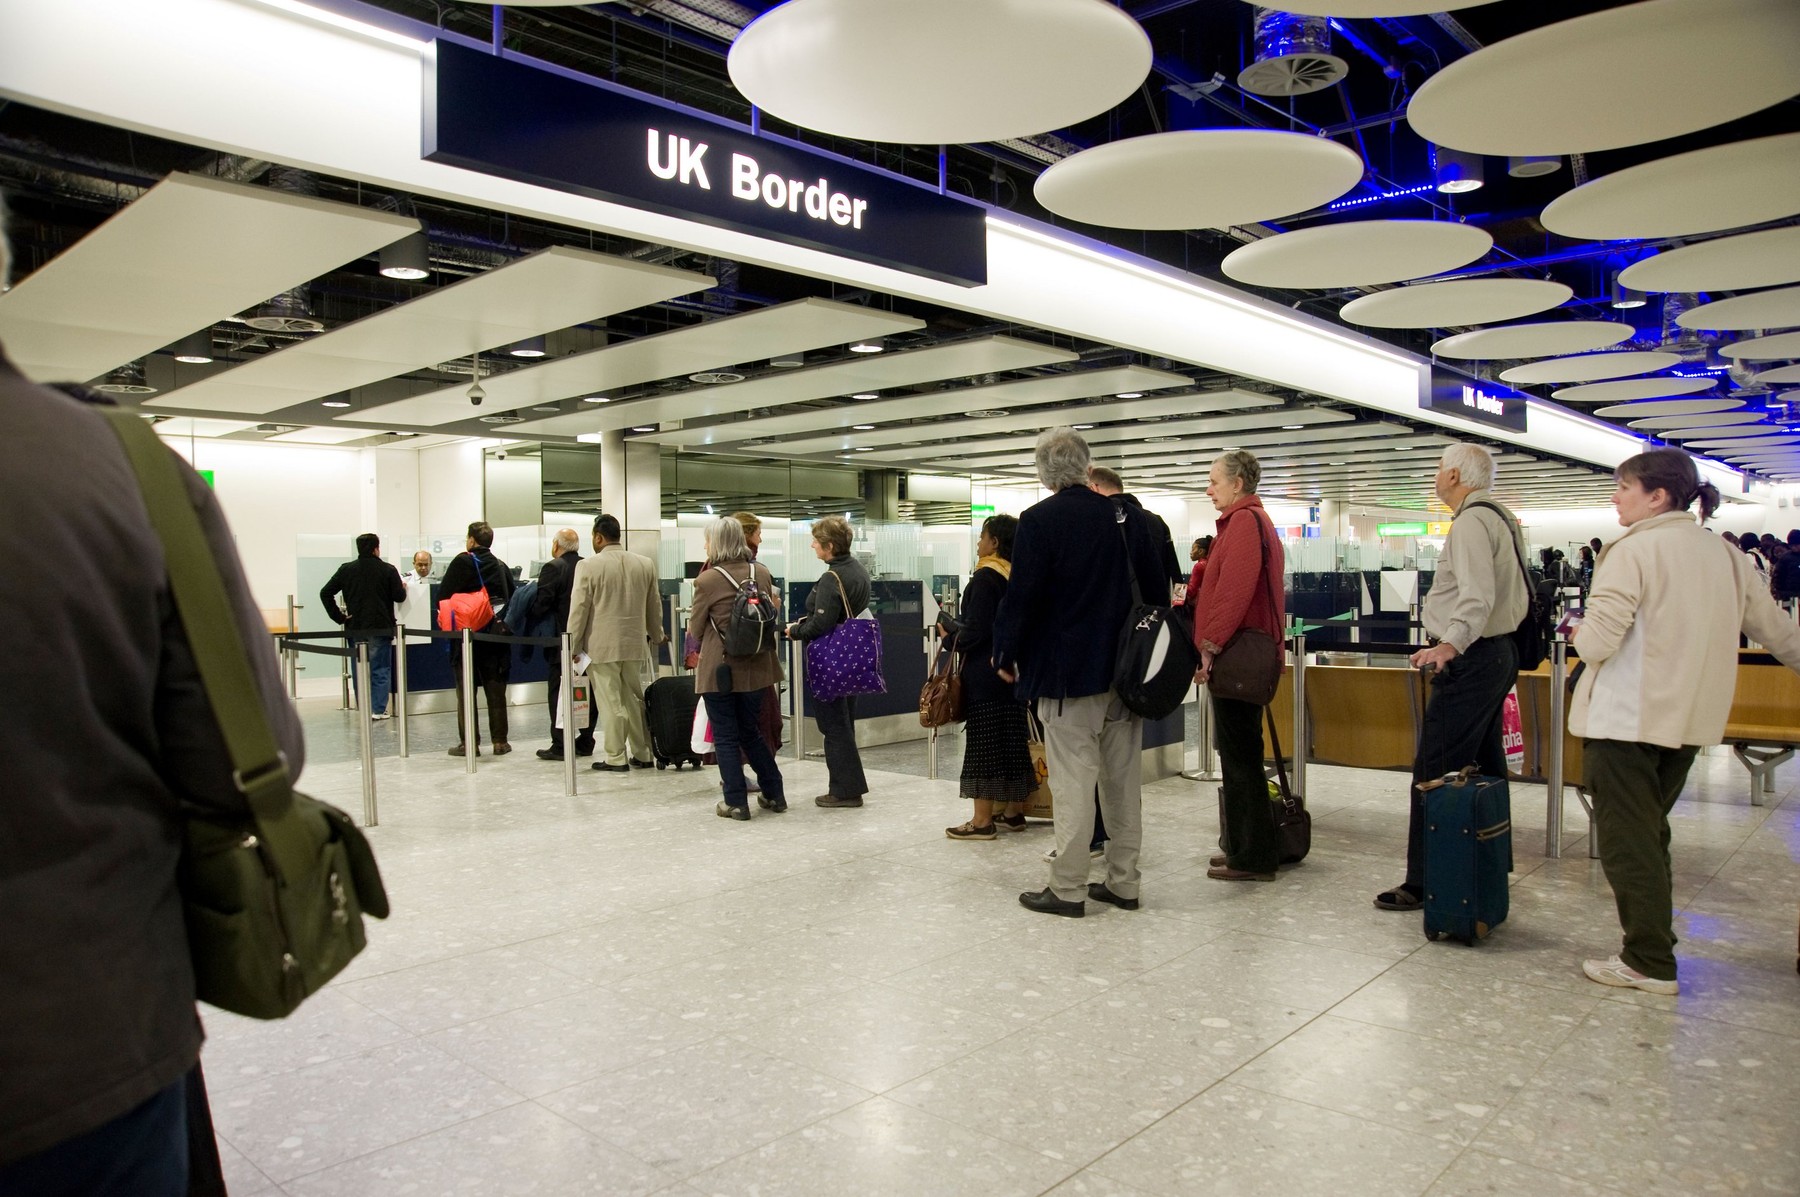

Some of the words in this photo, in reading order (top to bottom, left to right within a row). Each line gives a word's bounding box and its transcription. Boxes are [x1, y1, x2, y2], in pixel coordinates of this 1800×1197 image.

[647, 128, 711, 190] UK
[731, 152, 868, 230] Border
[1462, 385, 1476, 408] UK
[1476, 389, 1504, 416] Border
[433, 540, 443, 553] 8
[1502, 728, 1524, 754] pha
